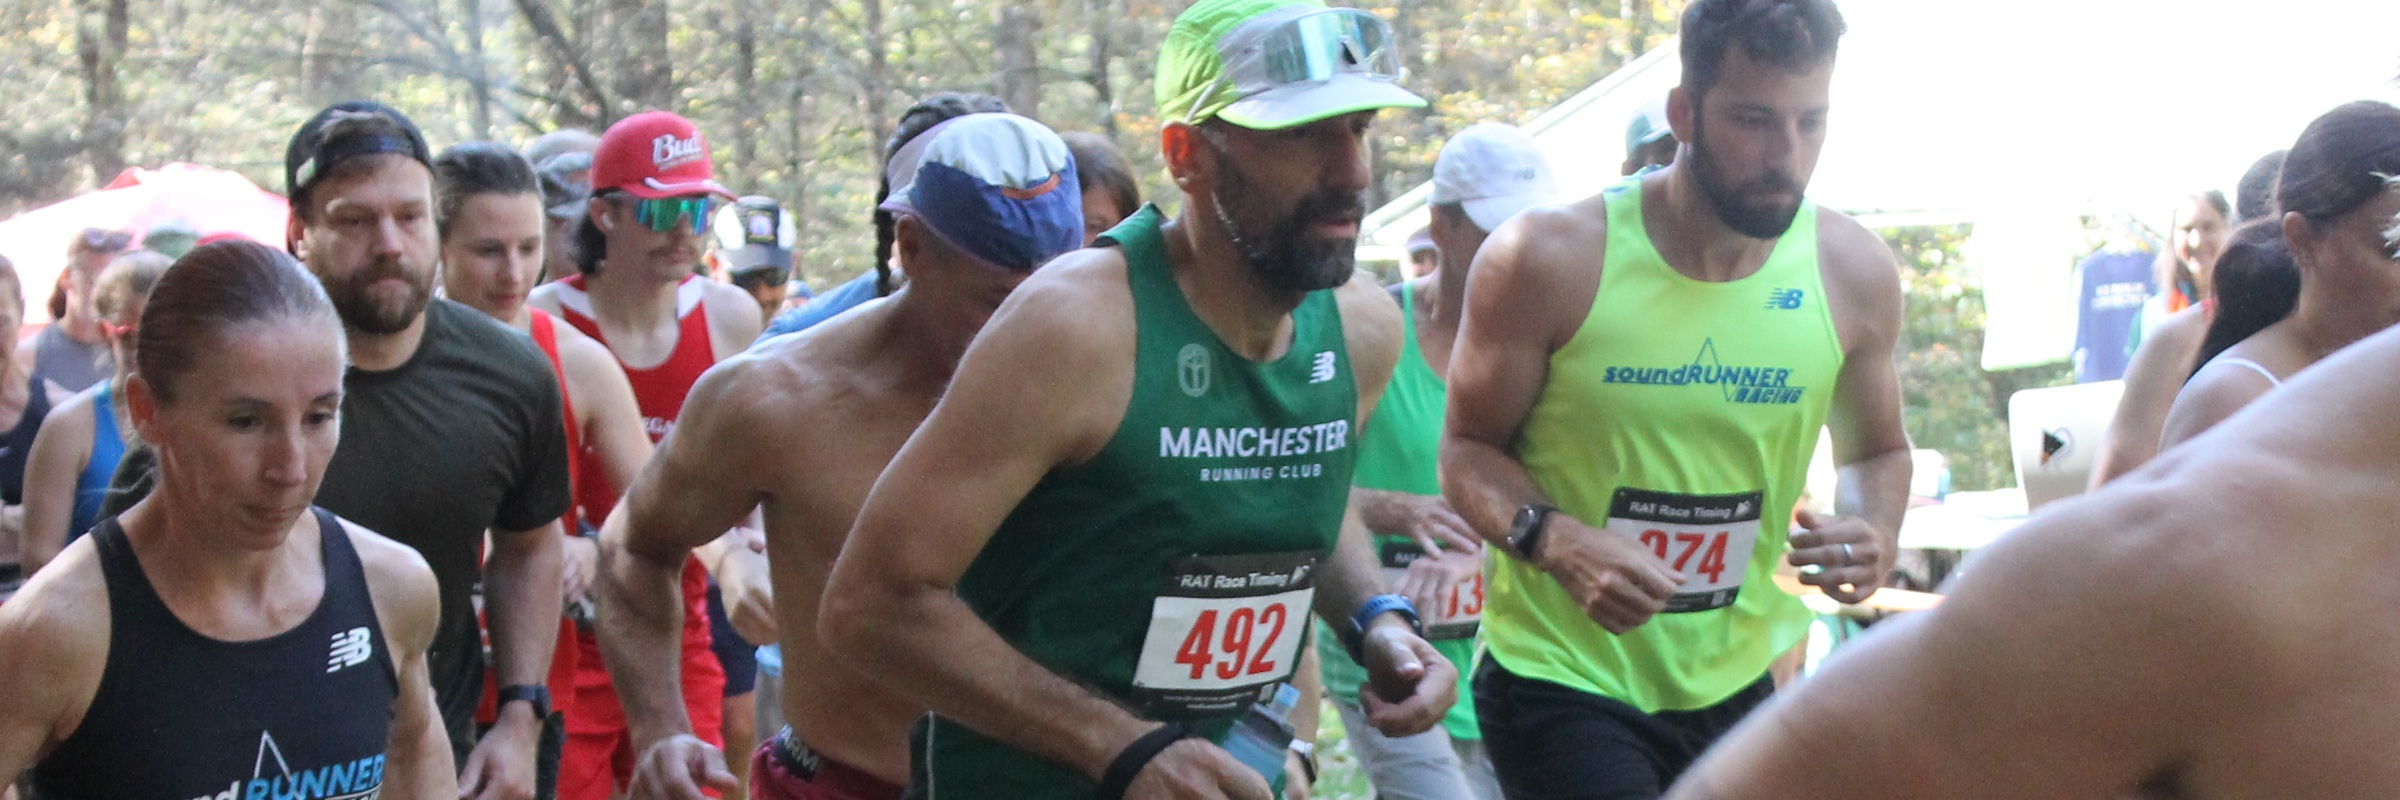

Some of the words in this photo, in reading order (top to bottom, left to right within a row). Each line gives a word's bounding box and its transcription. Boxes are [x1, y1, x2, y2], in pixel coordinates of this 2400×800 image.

[652, 130, 702, 165] Bud
[1733, 387, 1805, 404] RACING
[1159, 418, 1349, 458] MANCHESTER
[1200, 466, 1274, 482] RUNNING
[1279, 463, 1323, 479] CLUB
[1629, 501, 1657, 515] RAT
[1659, 504, 1691, 518] Race
[1693, 506, 1733, 519] Timing
[1180, 574, 1214, 588] RAT
[1214, 575, 1247, 589] Race
[1249, 571, 1290, 588] Timing
[1174, 602, 1287, 680] 492
